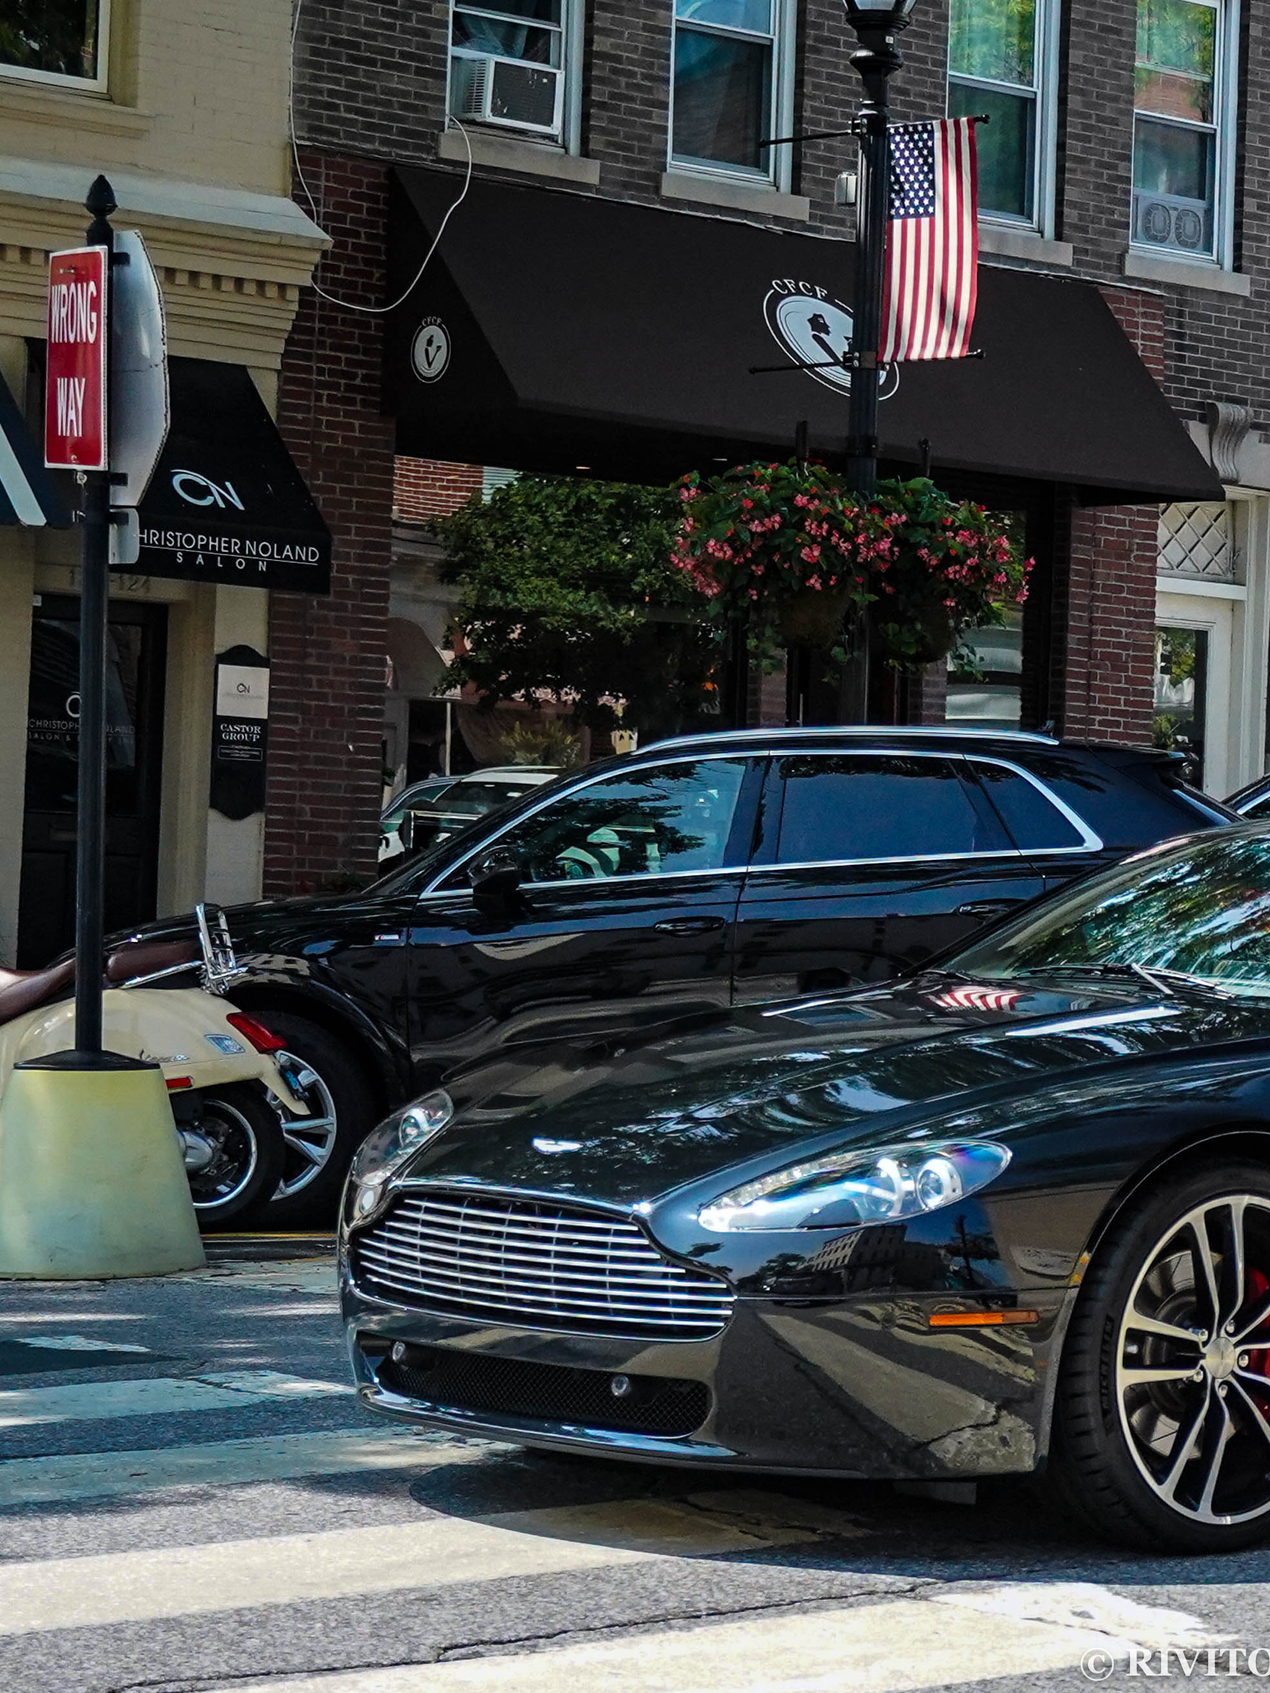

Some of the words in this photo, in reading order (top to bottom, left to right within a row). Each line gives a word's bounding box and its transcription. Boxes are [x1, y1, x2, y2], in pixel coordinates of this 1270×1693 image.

[772, 279, 828, 299] CFCF
[51, 281, 97, 344] WRONG
[57, 377, 86, 437] WAY
[139, 529, 240, 554] HRISTOPHER
[245, 540, 320, 562] NOLAND
[176, 552, 267, 571] SALON
[28, 718, 81, 730] CHRISTOPH
[220, 723, 262, 733] CASTOR
[222, 732, 260, 741] GROUP
